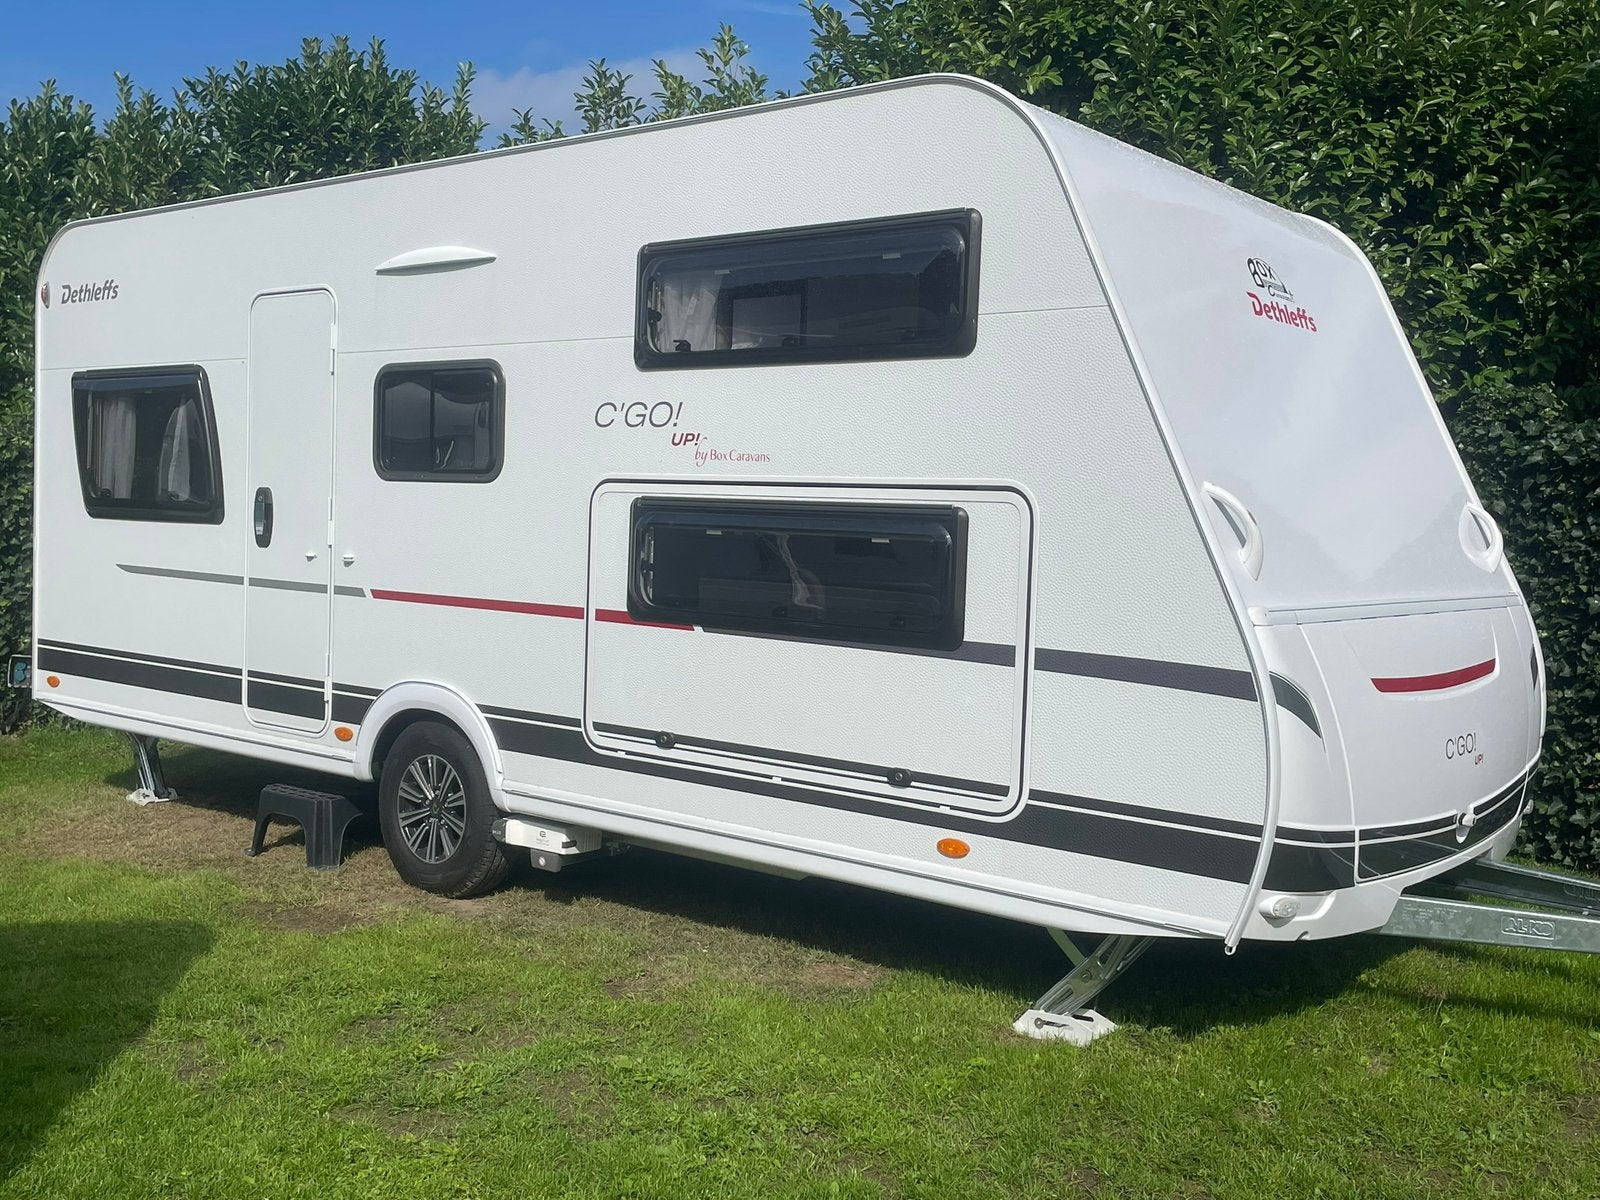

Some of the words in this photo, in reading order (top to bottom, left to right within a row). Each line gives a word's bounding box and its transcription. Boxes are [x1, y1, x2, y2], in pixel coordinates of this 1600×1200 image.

[61, 279, 119, 304] Dethleffs
[1246, 291, 1317, 332] Dethleffs
[595, 401, 683, 428] C'GO!
[671, 433, 700, 446] UP!
[695, 437, 708, 467] by
[710, 448, 728, 461] Box
[729, 448, 770, 463] Caravans
[1445, 732, 1477, 760] C'GO!
